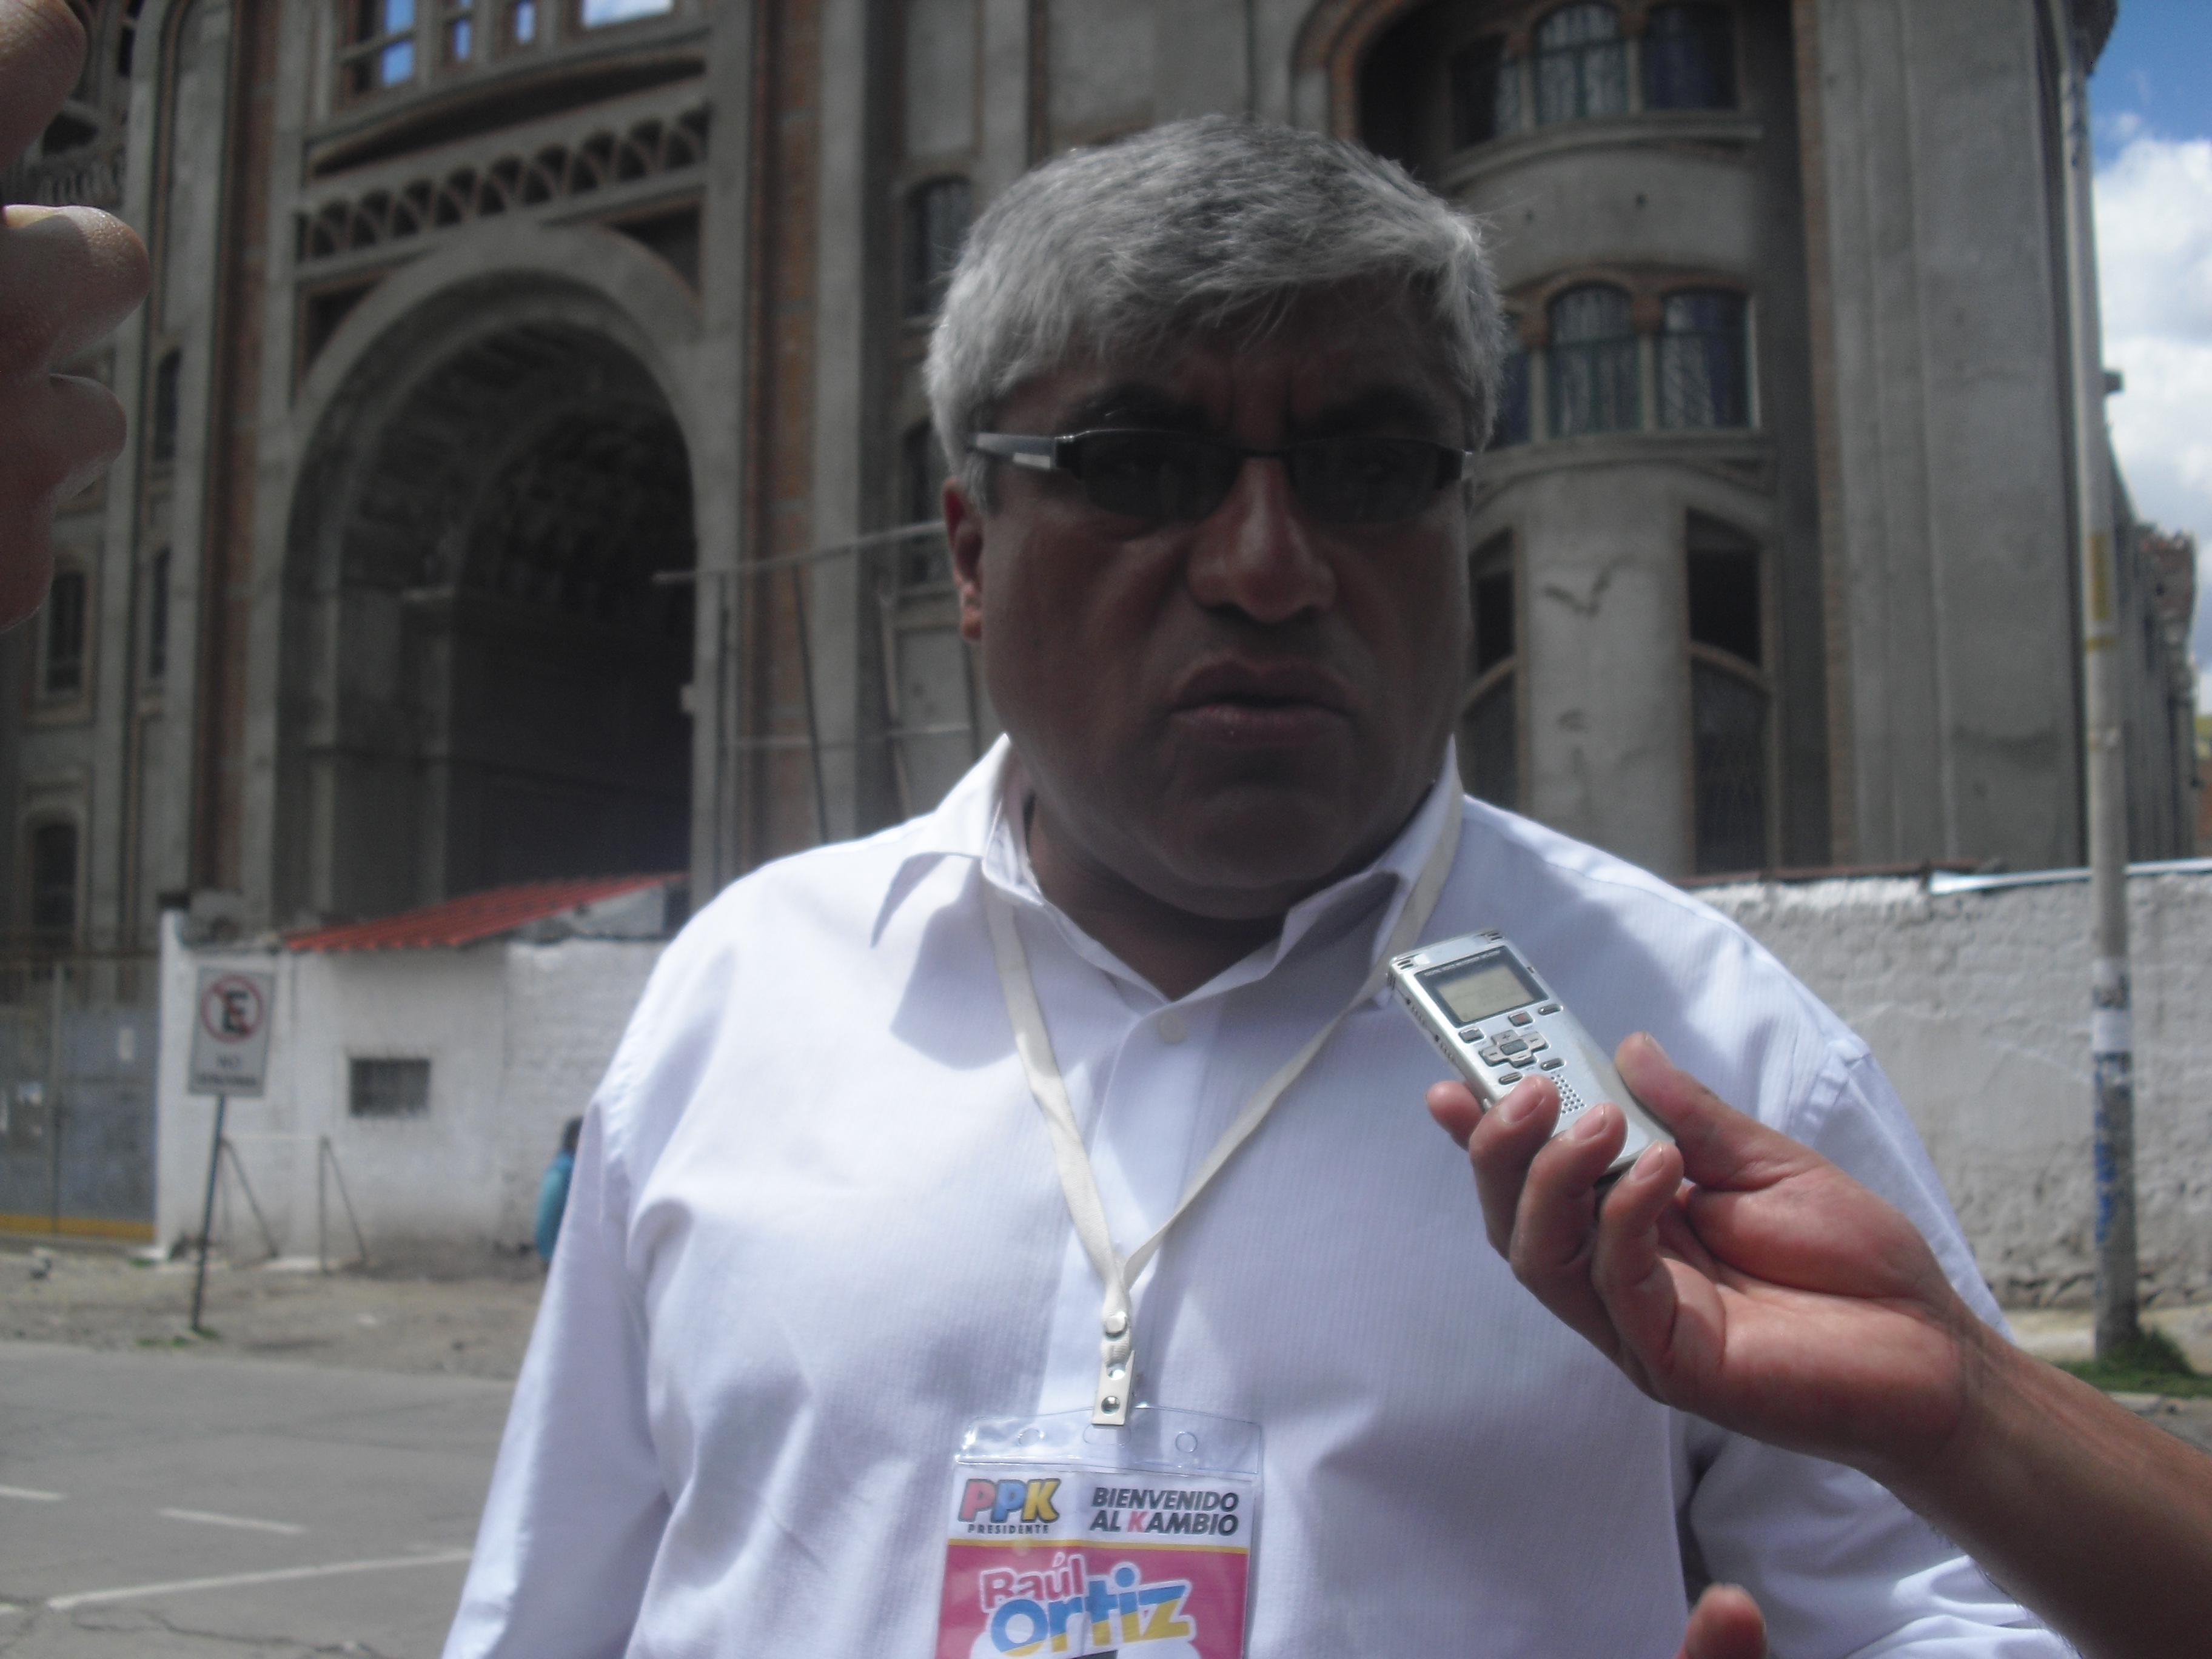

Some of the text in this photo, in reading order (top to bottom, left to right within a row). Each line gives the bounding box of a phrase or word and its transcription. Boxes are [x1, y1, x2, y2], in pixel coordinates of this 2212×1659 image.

[223, 990, 249, 1033] E
[957, 1478, 1061, 1523] PPK
[1092, 1487, 1239, 1512] BIENVENIDO
[968, 1524, 1049, 1534] PRESIDENTE
[1090, 1513, 1239, 1537] AL KAMBIO
[982, 1553, 1085, 1610] Raúl
